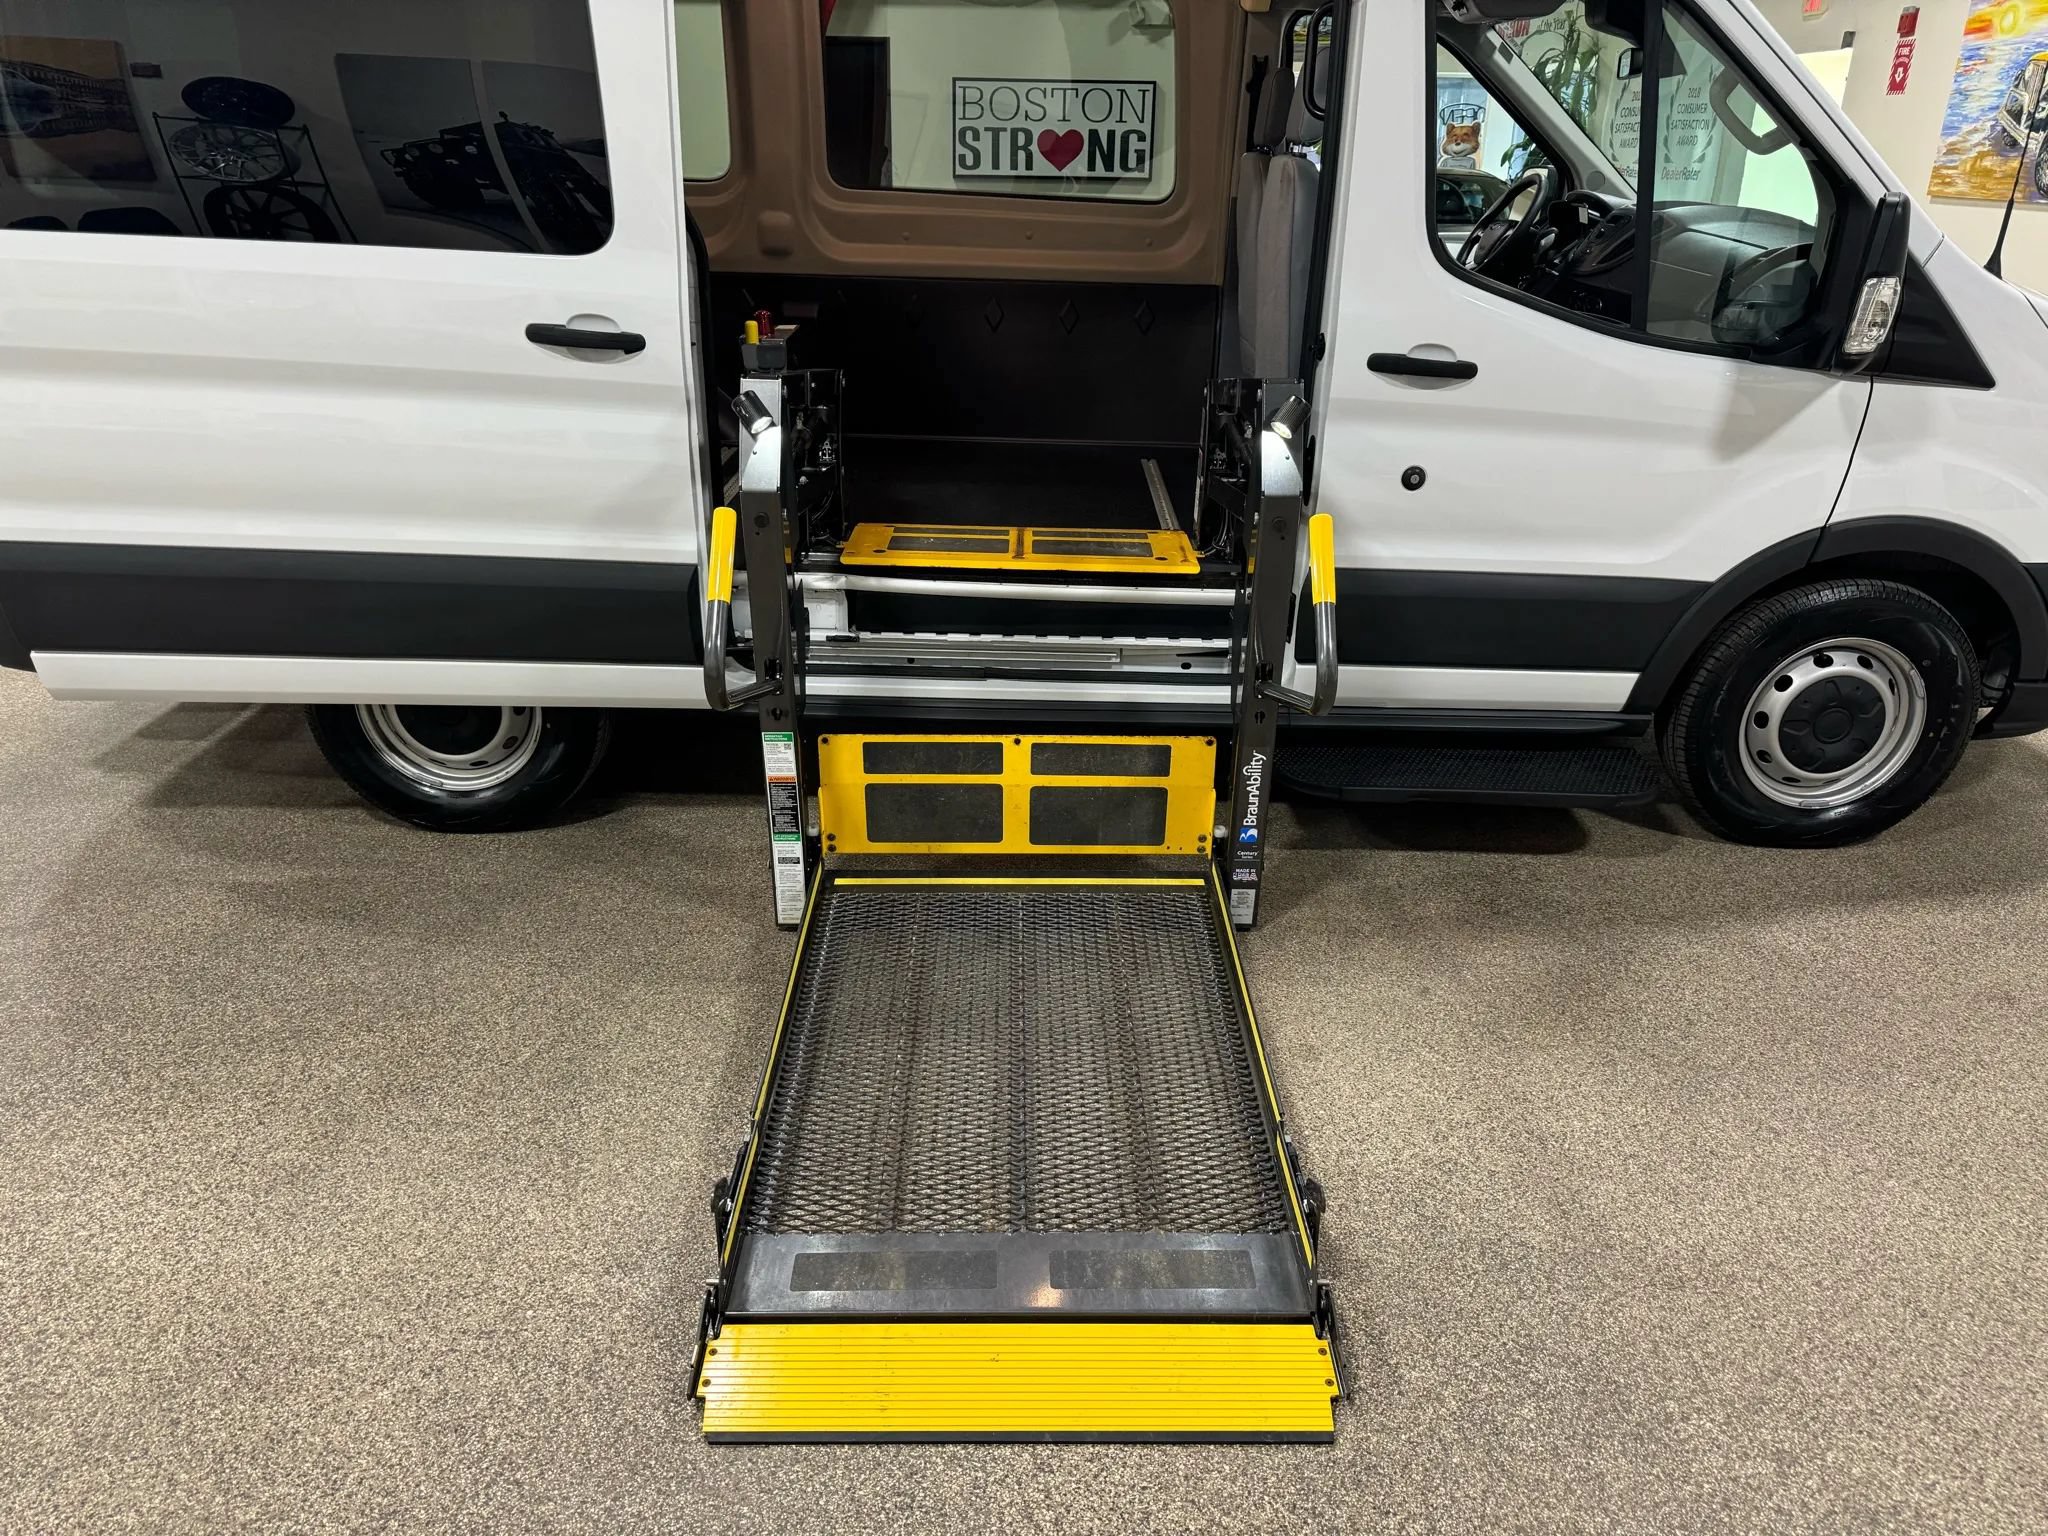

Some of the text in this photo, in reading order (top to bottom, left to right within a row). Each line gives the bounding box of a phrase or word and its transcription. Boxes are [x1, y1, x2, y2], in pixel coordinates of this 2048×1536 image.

[1898, 46, 1911, 56] FIRE
[1631, 90, 1640, 102] 201
[958, 85, 1150, 124] BOSTON
[1676, 103, 1708, 114] CONSUMER
[1614, 121, 1640, 134] SATISFACT
[1670, 119, 1710, 130] SATISFACTION
[1675, 135, 1699, 146] AWARD
[1660, 167, 1701, 181] DealerRater
[1243, 752, 1267, 826] BraunAbility
